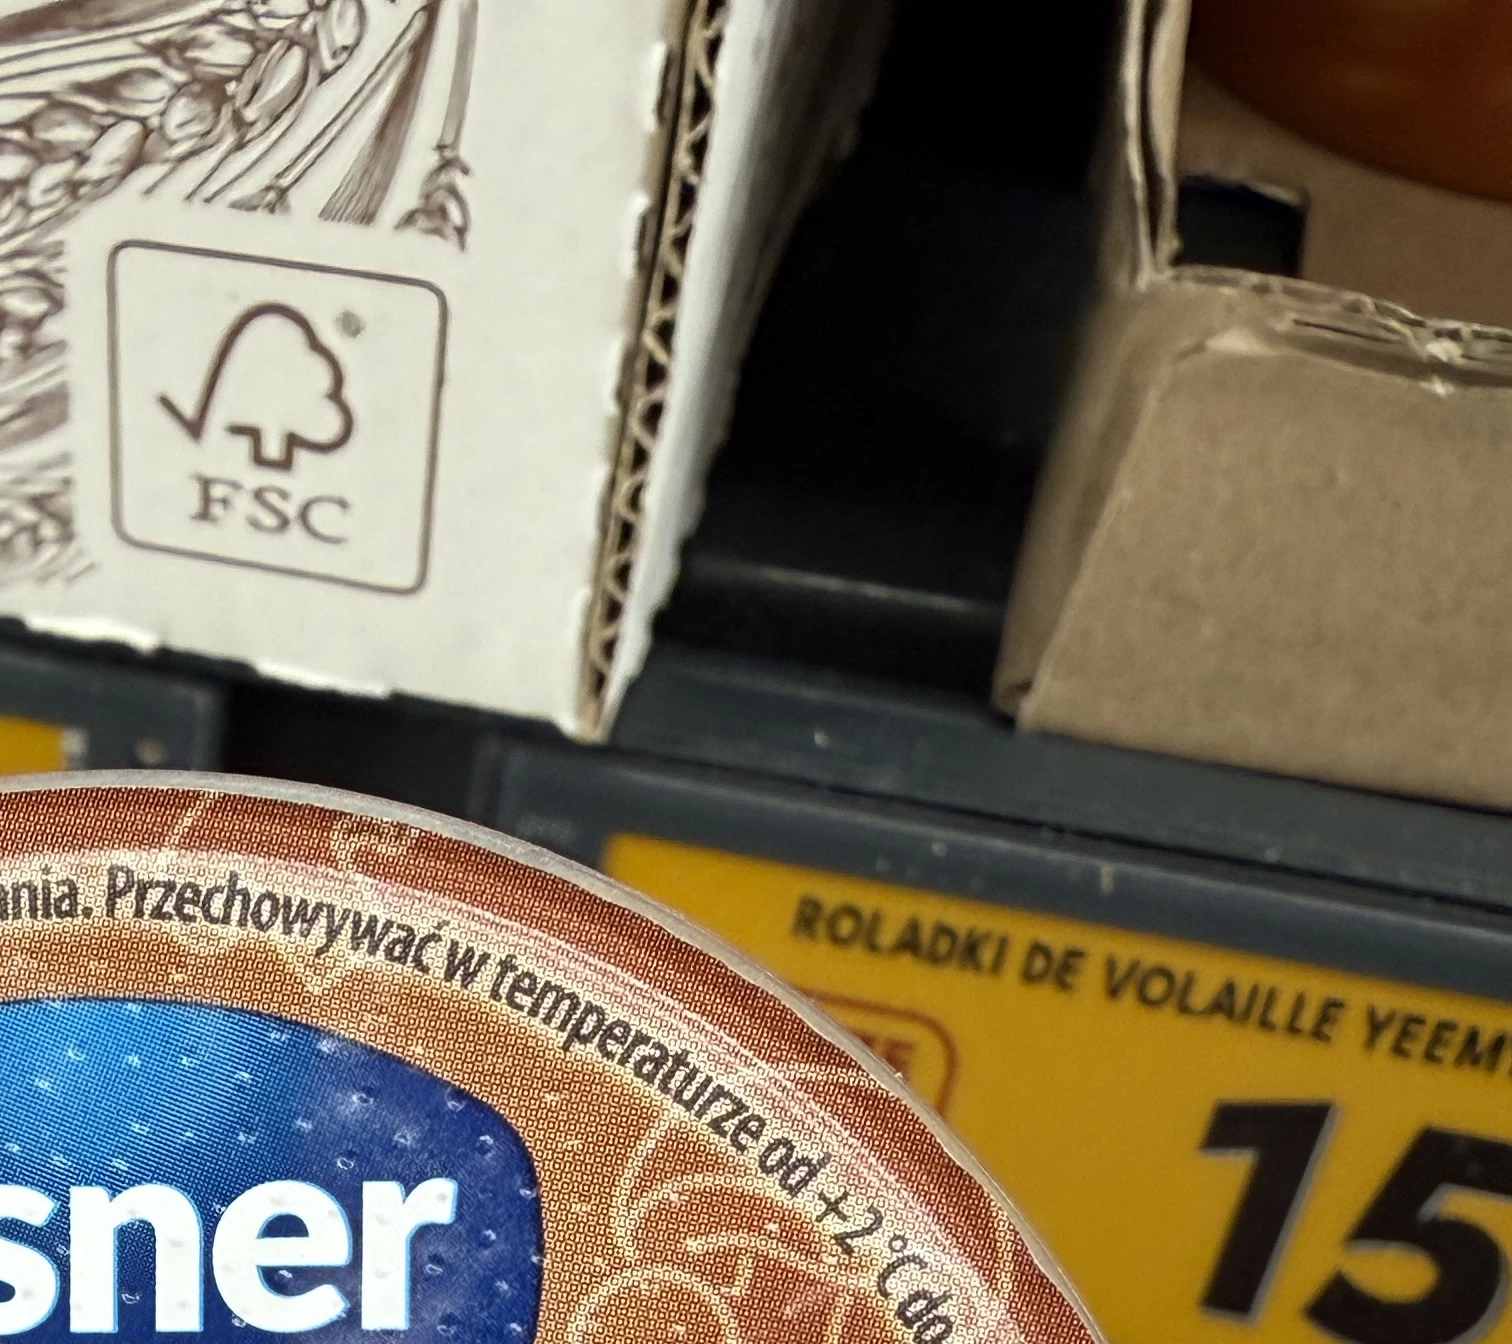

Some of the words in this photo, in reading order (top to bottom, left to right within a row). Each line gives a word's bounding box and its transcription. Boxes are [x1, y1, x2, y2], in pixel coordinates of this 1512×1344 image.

[188, 472, 351, 545] FSC
[107, 864, 449, 976] Przechowywać
[438, 938, 490, 989] w
[488, 953, 768, 1150] temperaturze
[758, 1137, 832, 1196] od
[791, 895, 1011, 978] ROLADKI
[1020, 943, 1090, 993] DE
[1105, 953, 1347, 1044] VOLAILLE
[1361, 1002, 1512, 1077] YEEM
